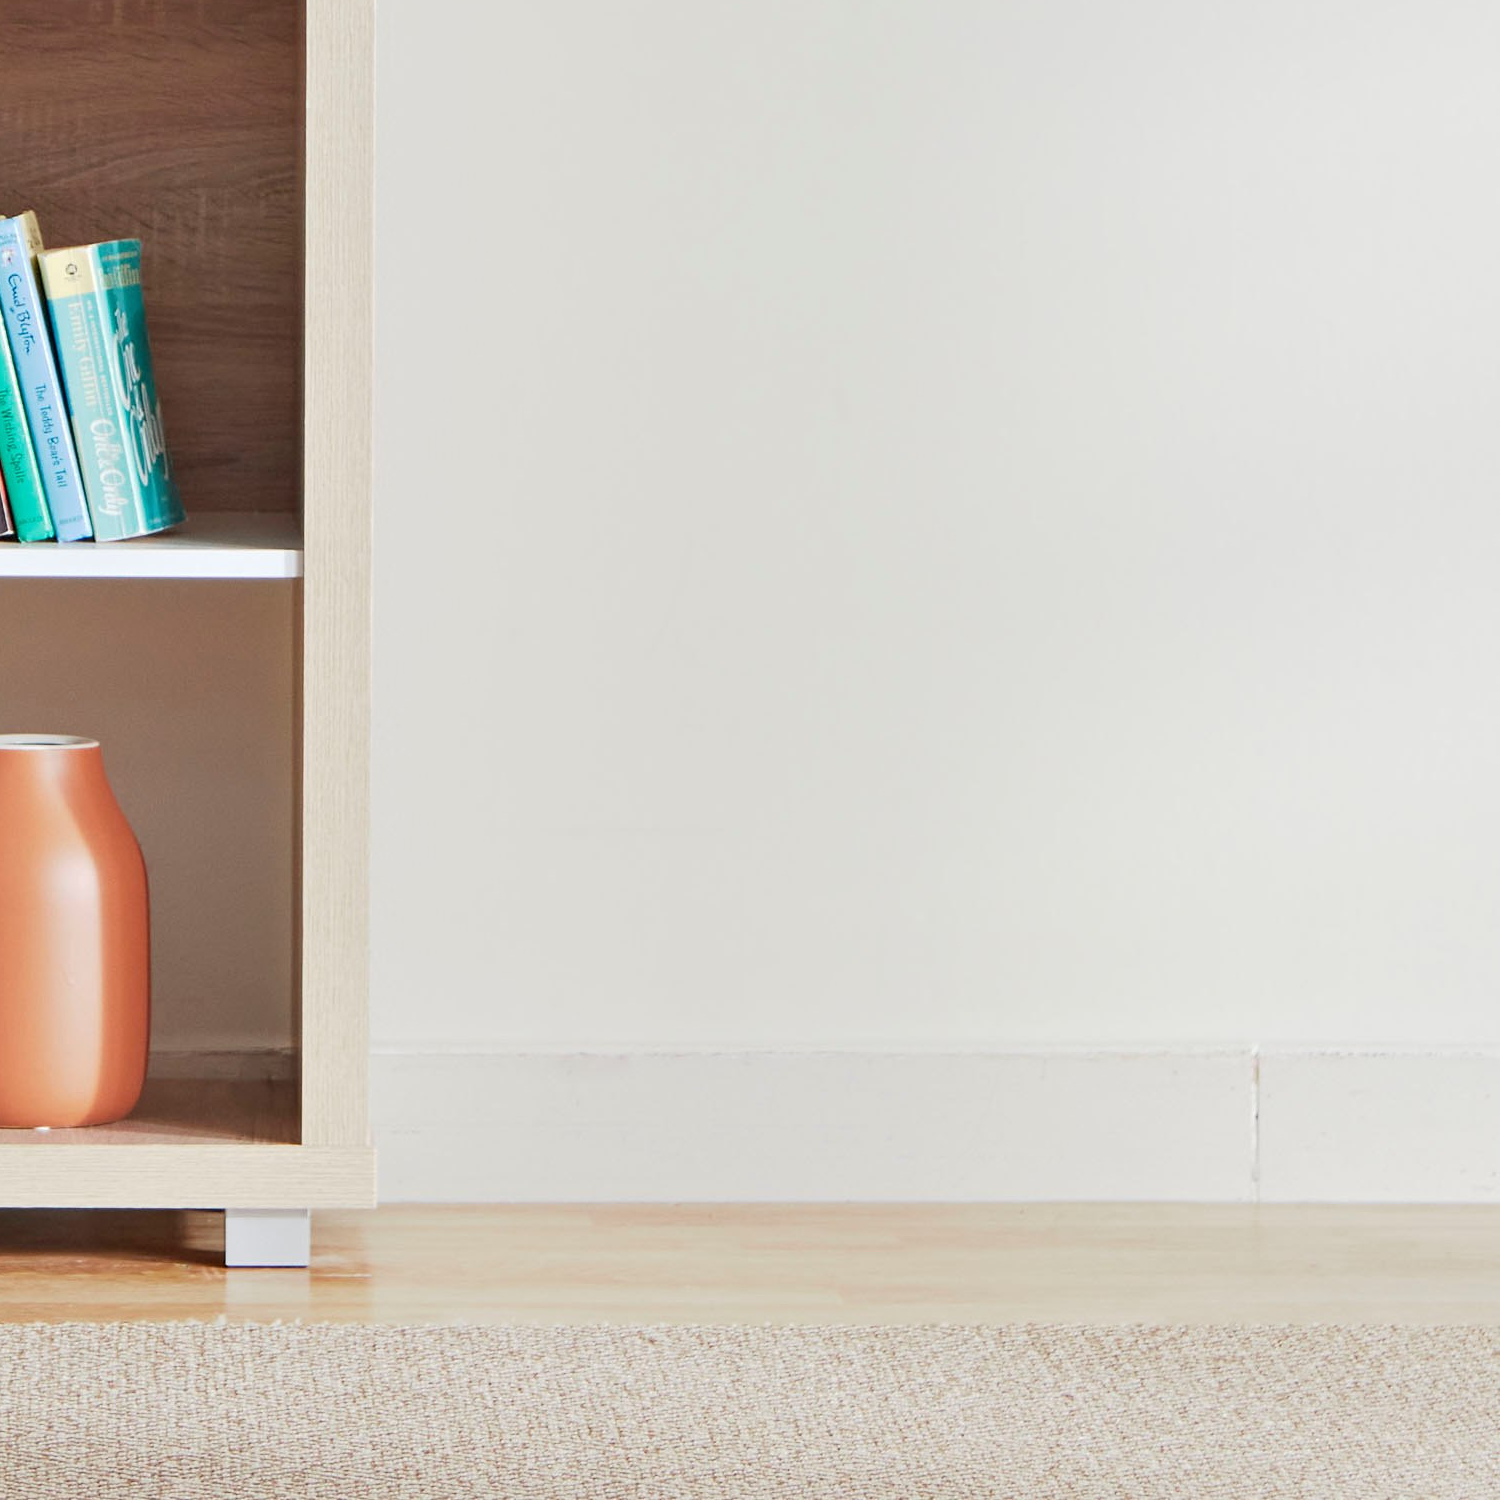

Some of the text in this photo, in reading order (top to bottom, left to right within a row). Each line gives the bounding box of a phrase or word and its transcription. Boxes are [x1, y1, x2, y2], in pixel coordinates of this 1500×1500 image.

[6, 272, 38, 356] Enid Blyton
[65, 301, 90, 352] Emily
[78, 356, 100, 407] Giffin
[8, 452, 27, 484] Spells
[34, 383, 69, 488] The Teddy Bear's Tail
[92, 466, 130, 518] Only
